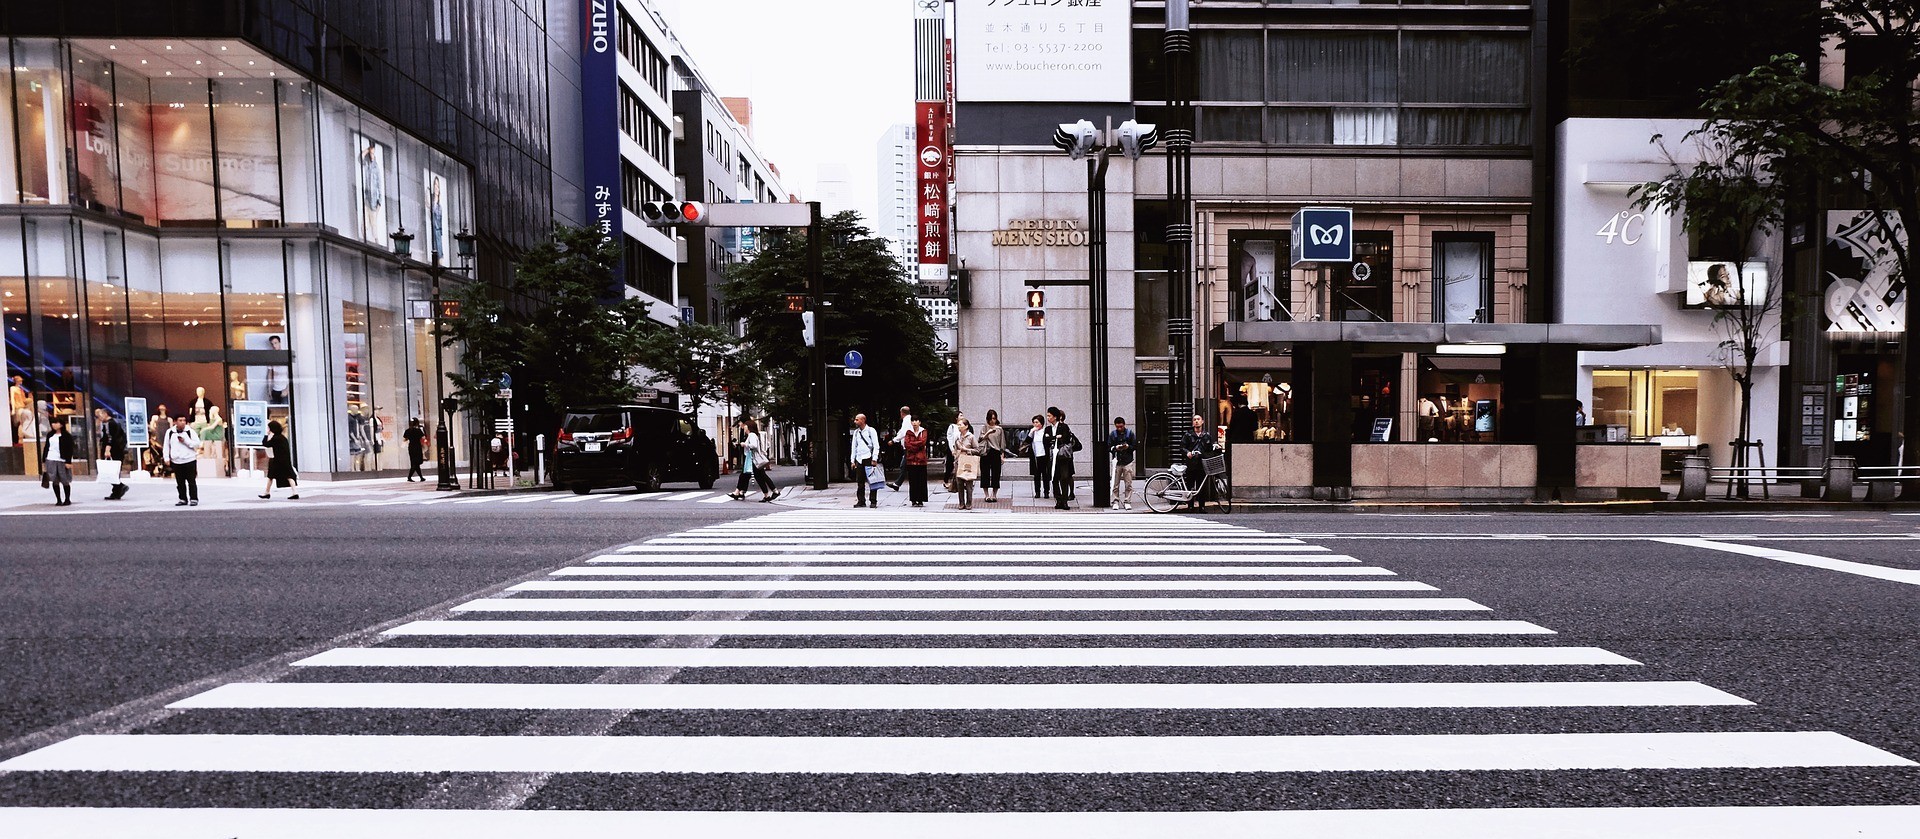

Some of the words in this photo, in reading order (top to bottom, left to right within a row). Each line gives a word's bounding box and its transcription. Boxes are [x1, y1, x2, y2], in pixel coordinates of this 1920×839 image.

[985, 60, 1103, 71] www.boucheron.com
[1009, 219, 1078, 231] TEIJIN
[992, 231, 1042, 247] MEN'S
[935, 342, 949, 352] 22
[240, 416, 262, 427] 50%
